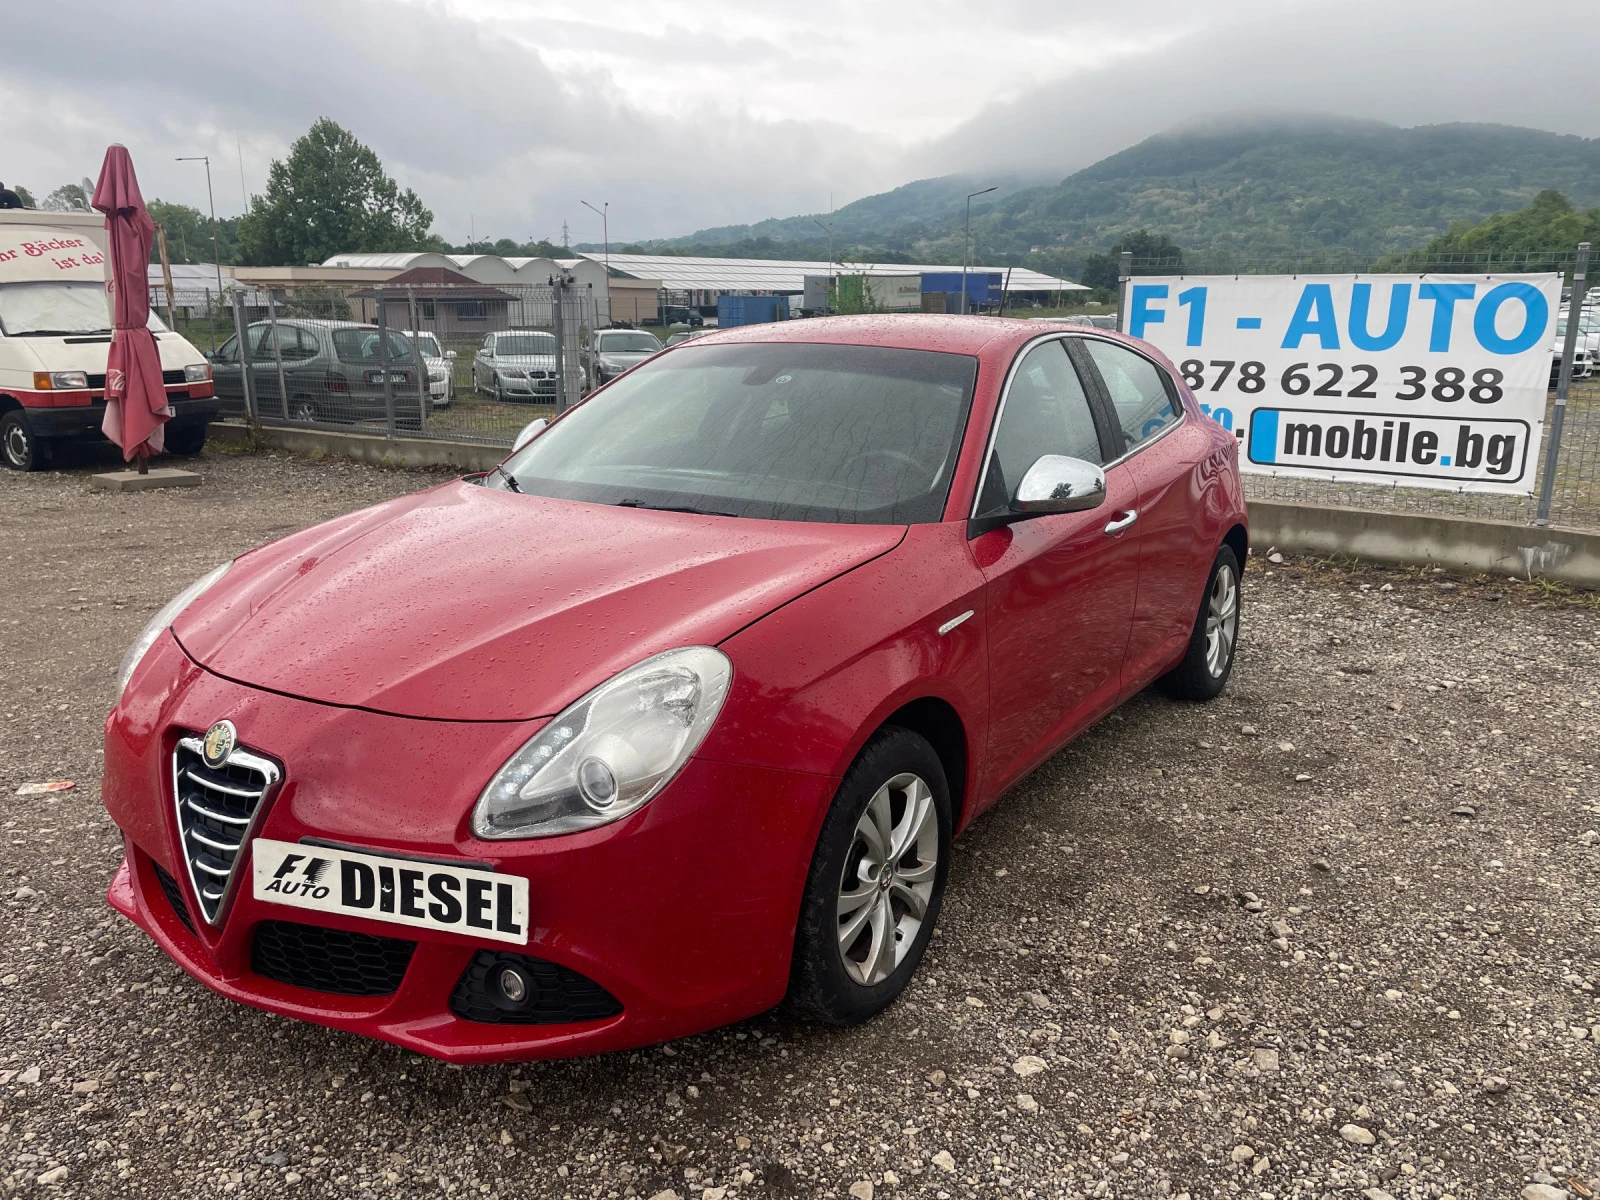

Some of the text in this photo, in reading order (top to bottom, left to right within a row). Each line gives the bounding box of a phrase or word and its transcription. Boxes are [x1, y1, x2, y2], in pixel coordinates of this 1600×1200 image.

[20, 238, 84, 257] Bäcker
[51, 257, 80, 270] ist
[1129, 284, 1208, 347] F1
[1281, 282, 1549, 356] AUTO
[1180, 359, 1504, 404] 878 622 388
[1283, 419, 1517, 475] mobile.bg
[264, 879, 330, 900] AUTO
[340, 858, 522, 936] DIESEL
